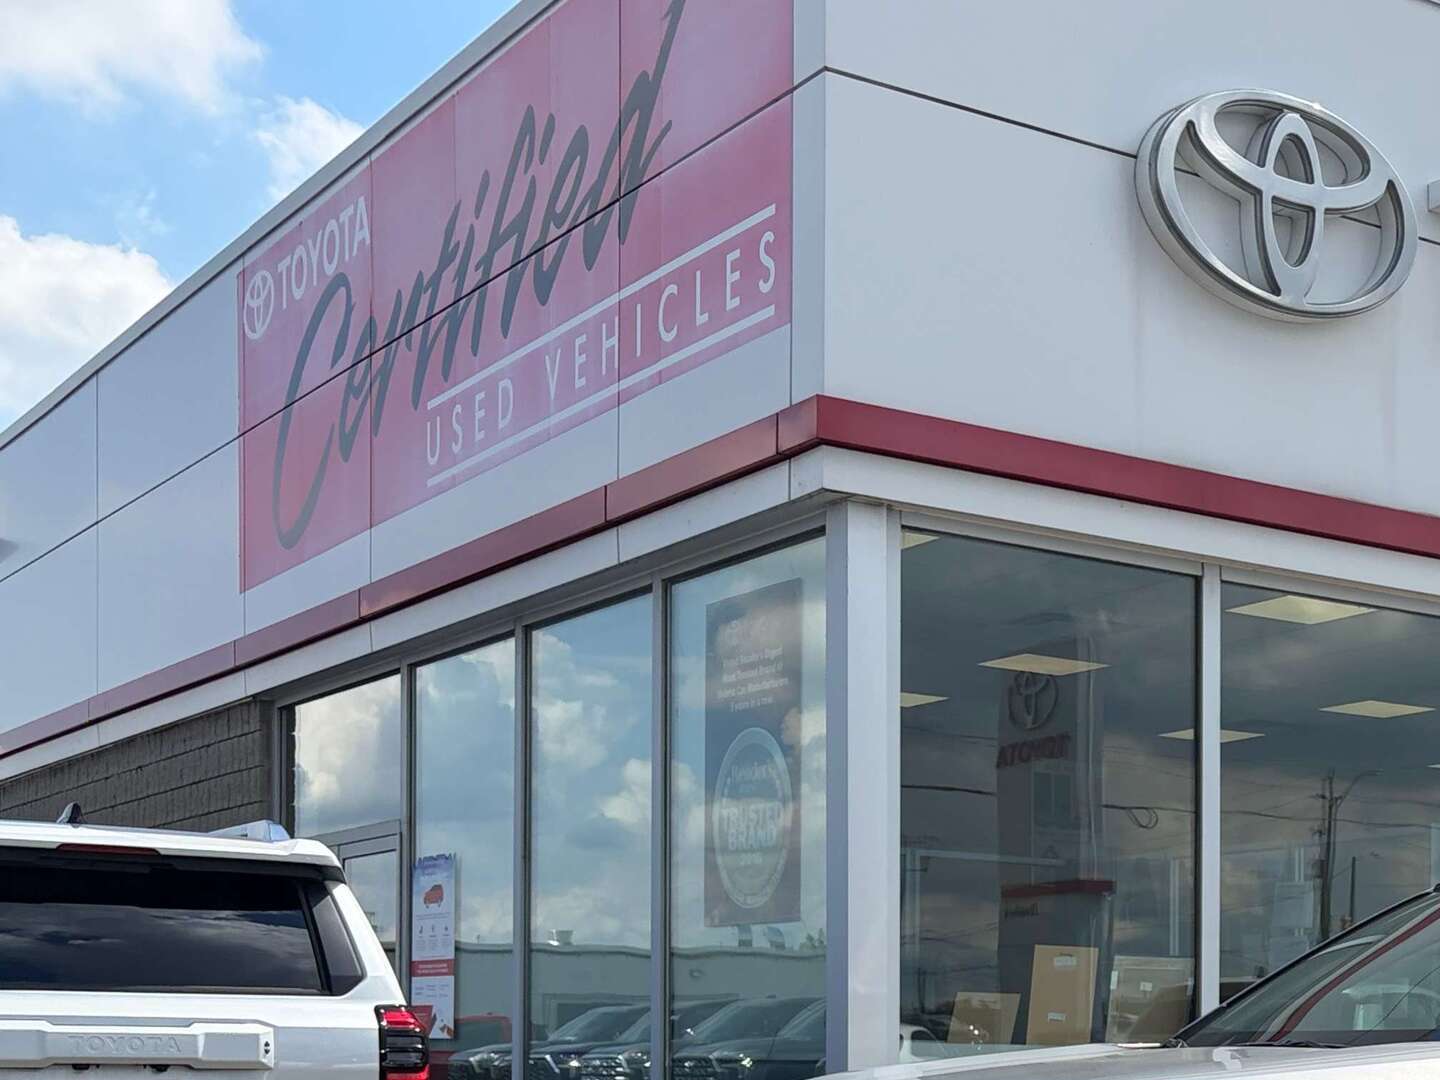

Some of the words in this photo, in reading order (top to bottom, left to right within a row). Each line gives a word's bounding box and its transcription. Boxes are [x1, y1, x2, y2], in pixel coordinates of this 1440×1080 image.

[273, 0, 686, 549] Certified
[278, 196, 370, 309] TOYOTA
[427, 377, 513, 466] USED
[545, 231, 776, 401] VEHICLES
[67, 1035, 182, 1055] TOYOTA
